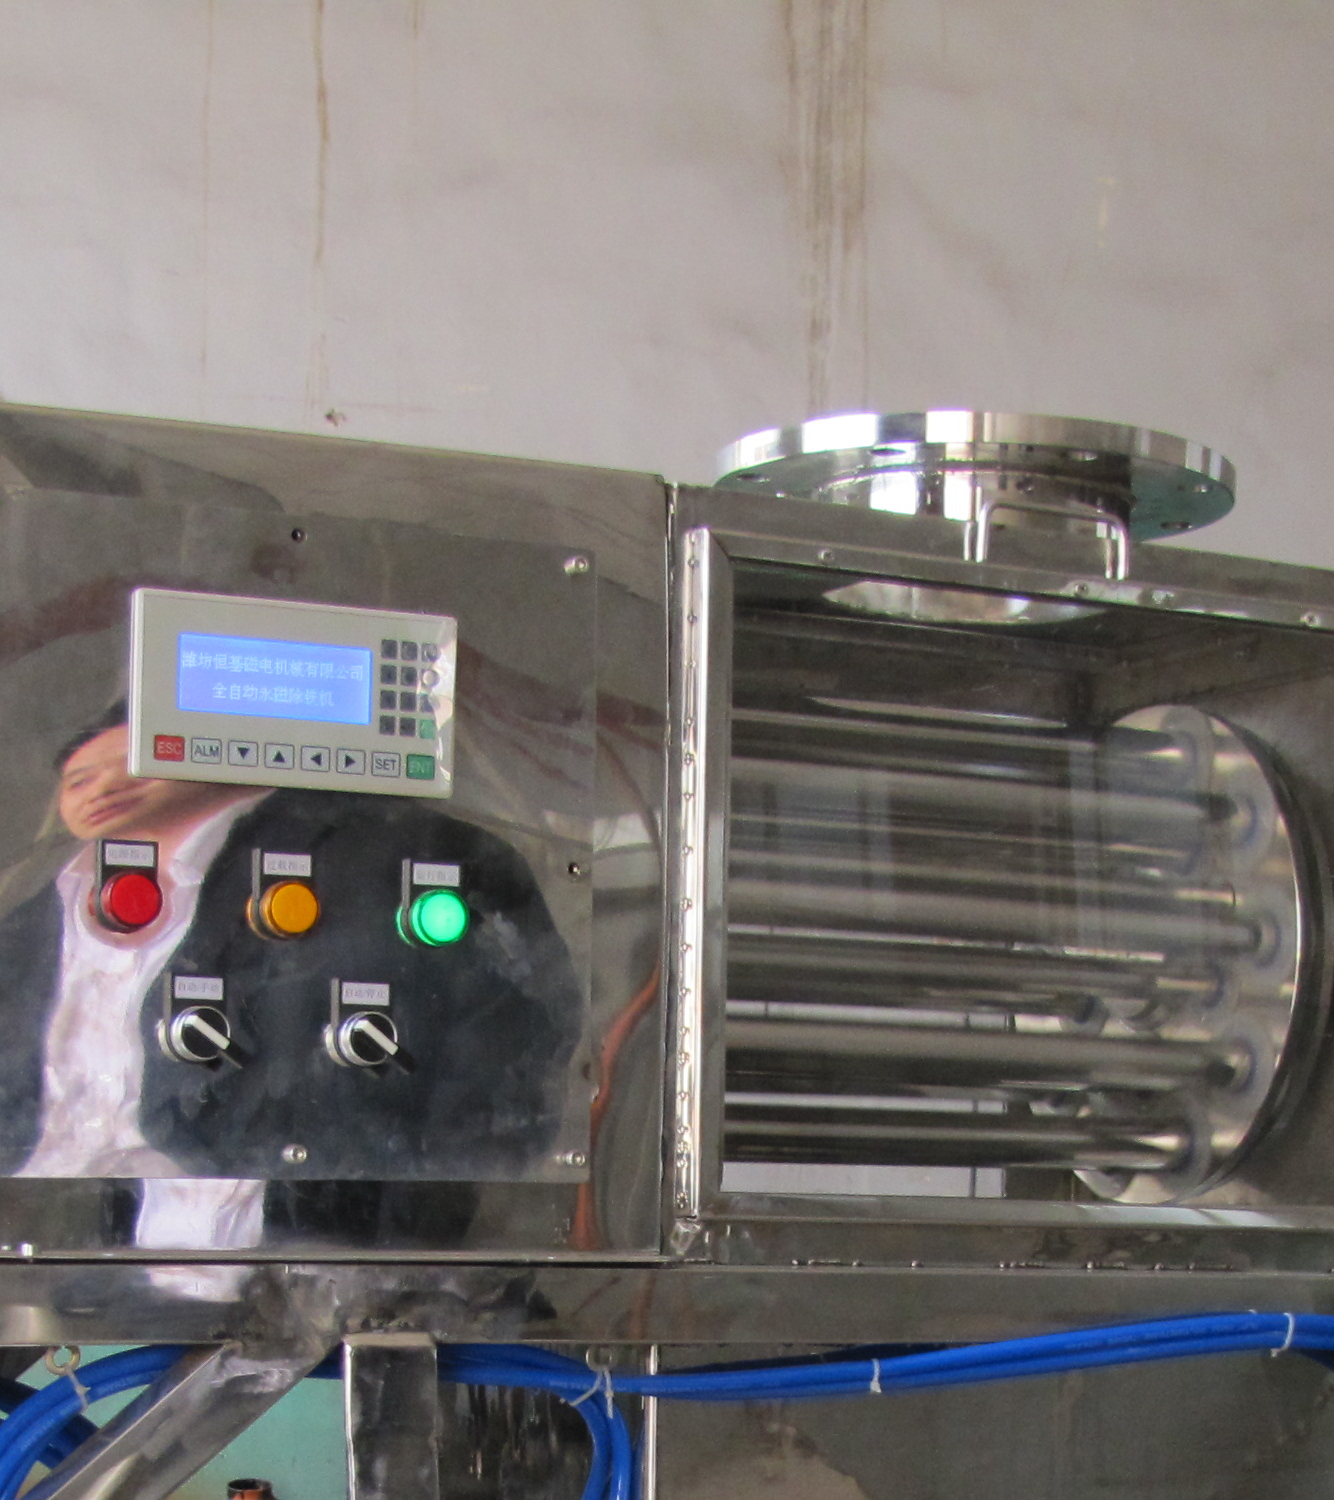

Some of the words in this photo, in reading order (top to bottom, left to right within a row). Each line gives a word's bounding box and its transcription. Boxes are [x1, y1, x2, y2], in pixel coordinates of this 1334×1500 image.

[157, 741, 183, 755] ESC
[194, 744, 220, 758] ALM
[375, 758, 397, 771] SET
